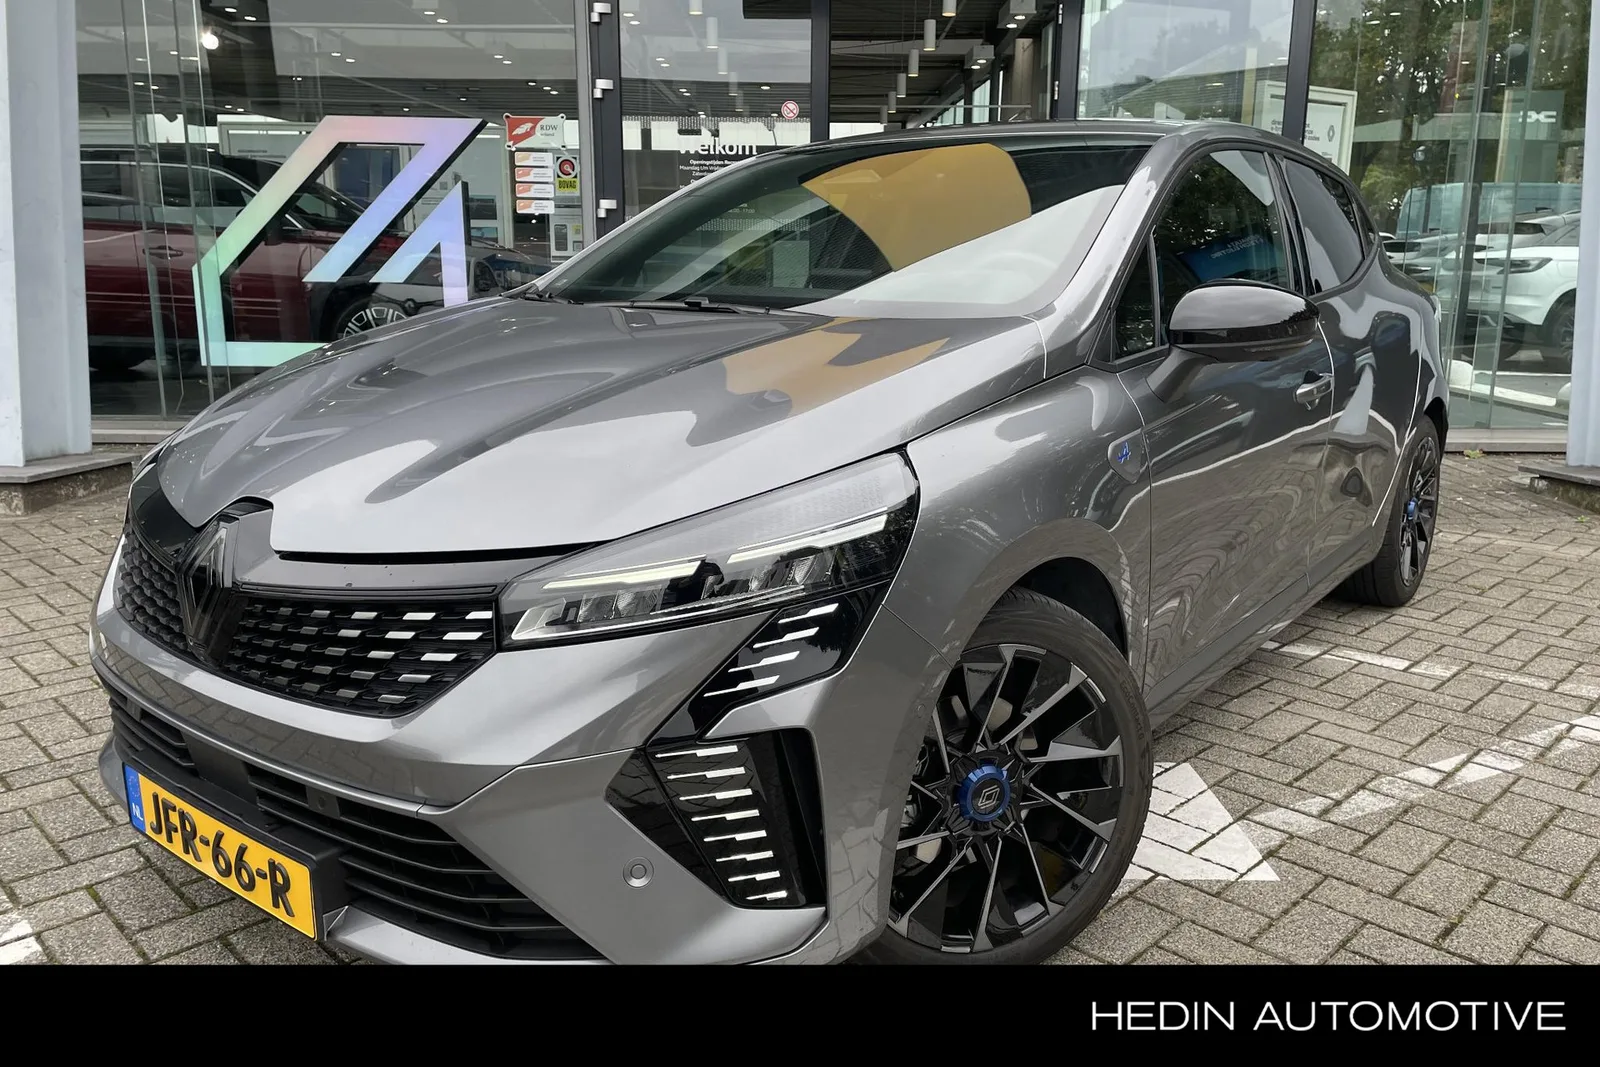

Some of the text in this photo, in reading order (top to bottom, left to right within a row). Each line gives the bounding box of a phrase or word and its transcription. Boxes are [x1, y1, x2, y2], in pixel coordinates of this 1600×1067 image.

[679, 136, 758, 155] elkom
[558, 179, 577, 189] BOVAG
[132, 802, 144, 821] NL
[149, 791, 296, 919] JFR-66-R
